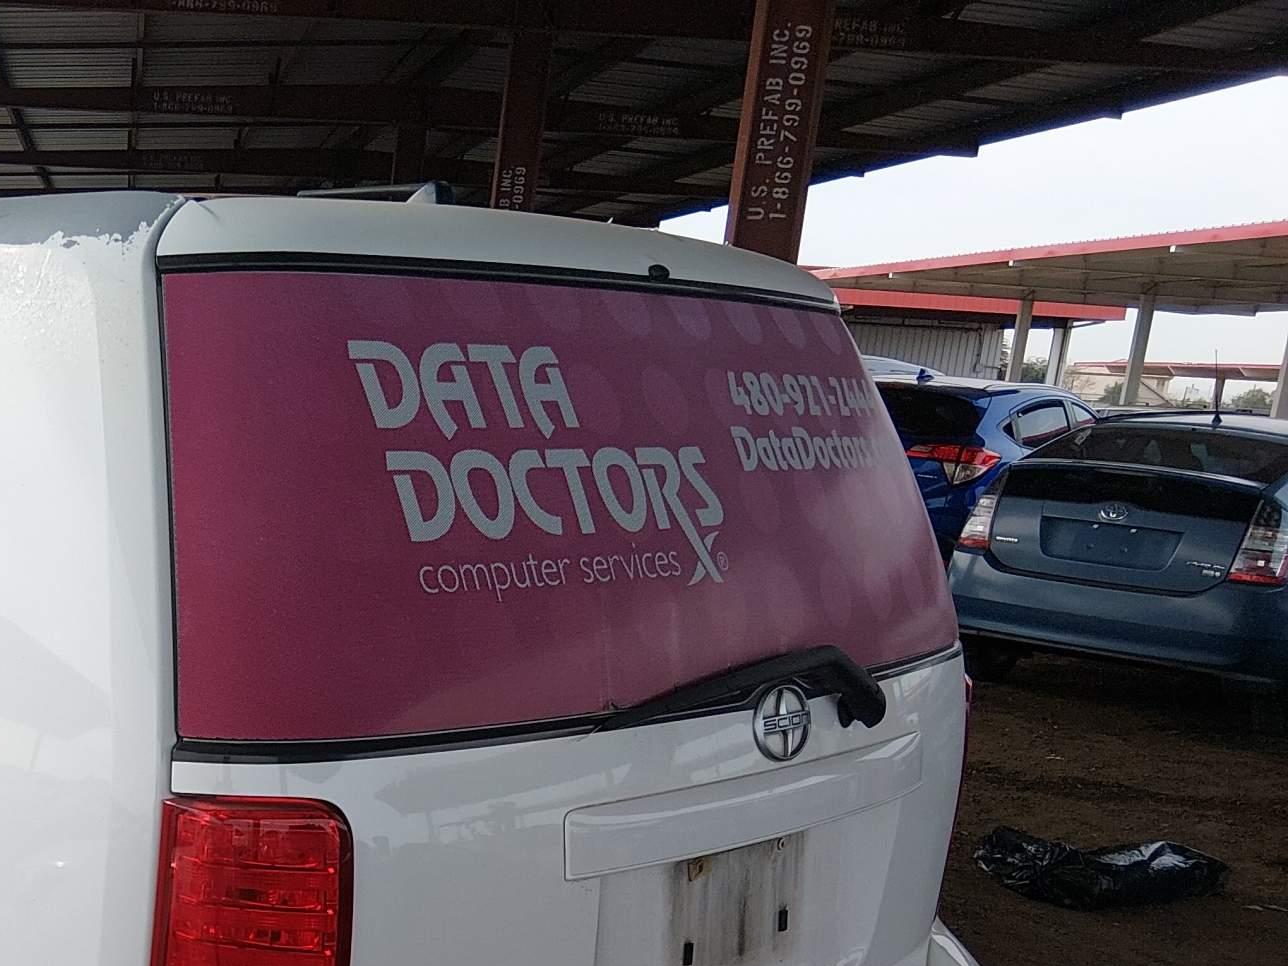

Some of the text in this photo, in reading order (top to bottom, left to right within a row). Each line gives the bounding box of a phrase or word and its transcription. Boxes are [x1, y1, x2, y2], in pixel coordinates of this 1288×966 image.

[747, 22, 792, 221] U.S. PREFAB INC.
[769, 24, 812, 219] 1-866-799-0969
[347, 339, 580, 441] DATA
[385, 446, 725, 586] DOCTORS
[418, 543, 682, 602] computer services
